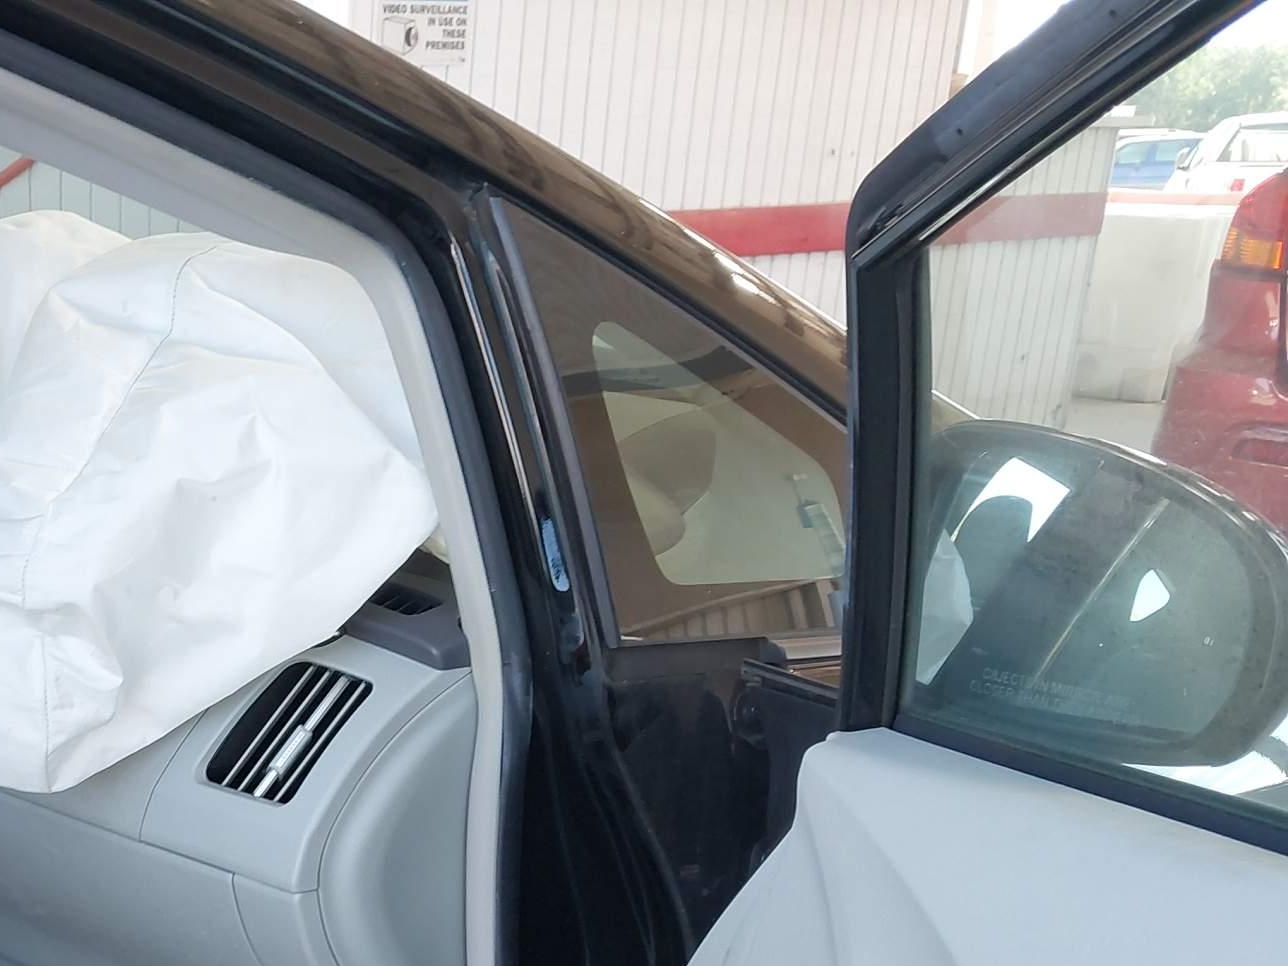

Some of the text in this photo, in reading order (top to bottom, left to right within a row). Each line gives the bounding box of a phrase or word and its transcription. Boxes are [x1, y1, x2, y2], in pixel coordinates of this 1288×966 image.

[383, 4, 468, 15] VIDEO SURVEILLANCE
[427, 17, 467, 26] IN USE ON
[442, 28, 466, 38] THESE
[425, 41, 465, 50] PREMISES
